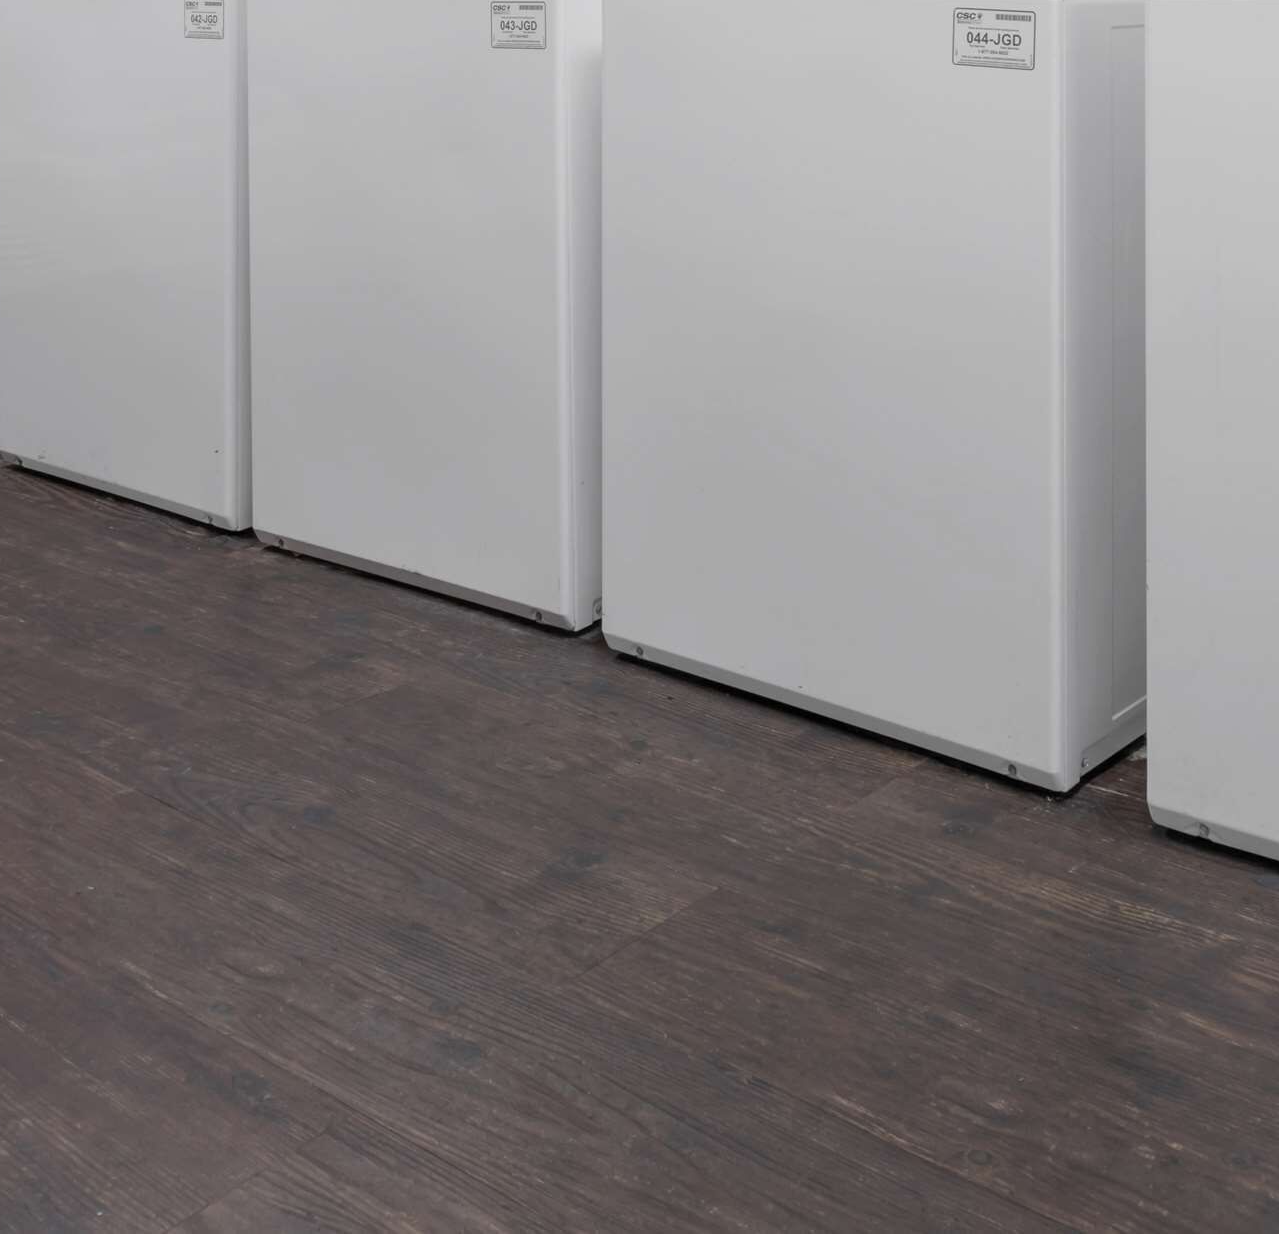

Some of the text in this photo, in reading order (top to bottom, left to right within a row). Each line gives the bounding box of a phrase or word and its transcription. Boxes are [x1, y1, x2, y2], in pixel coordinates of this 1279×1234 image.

[956, 12, 976, 20] CSC
[500, 20, 538, 31] 043-JGD
[966, 31, 1022, 47] 044-JGD
